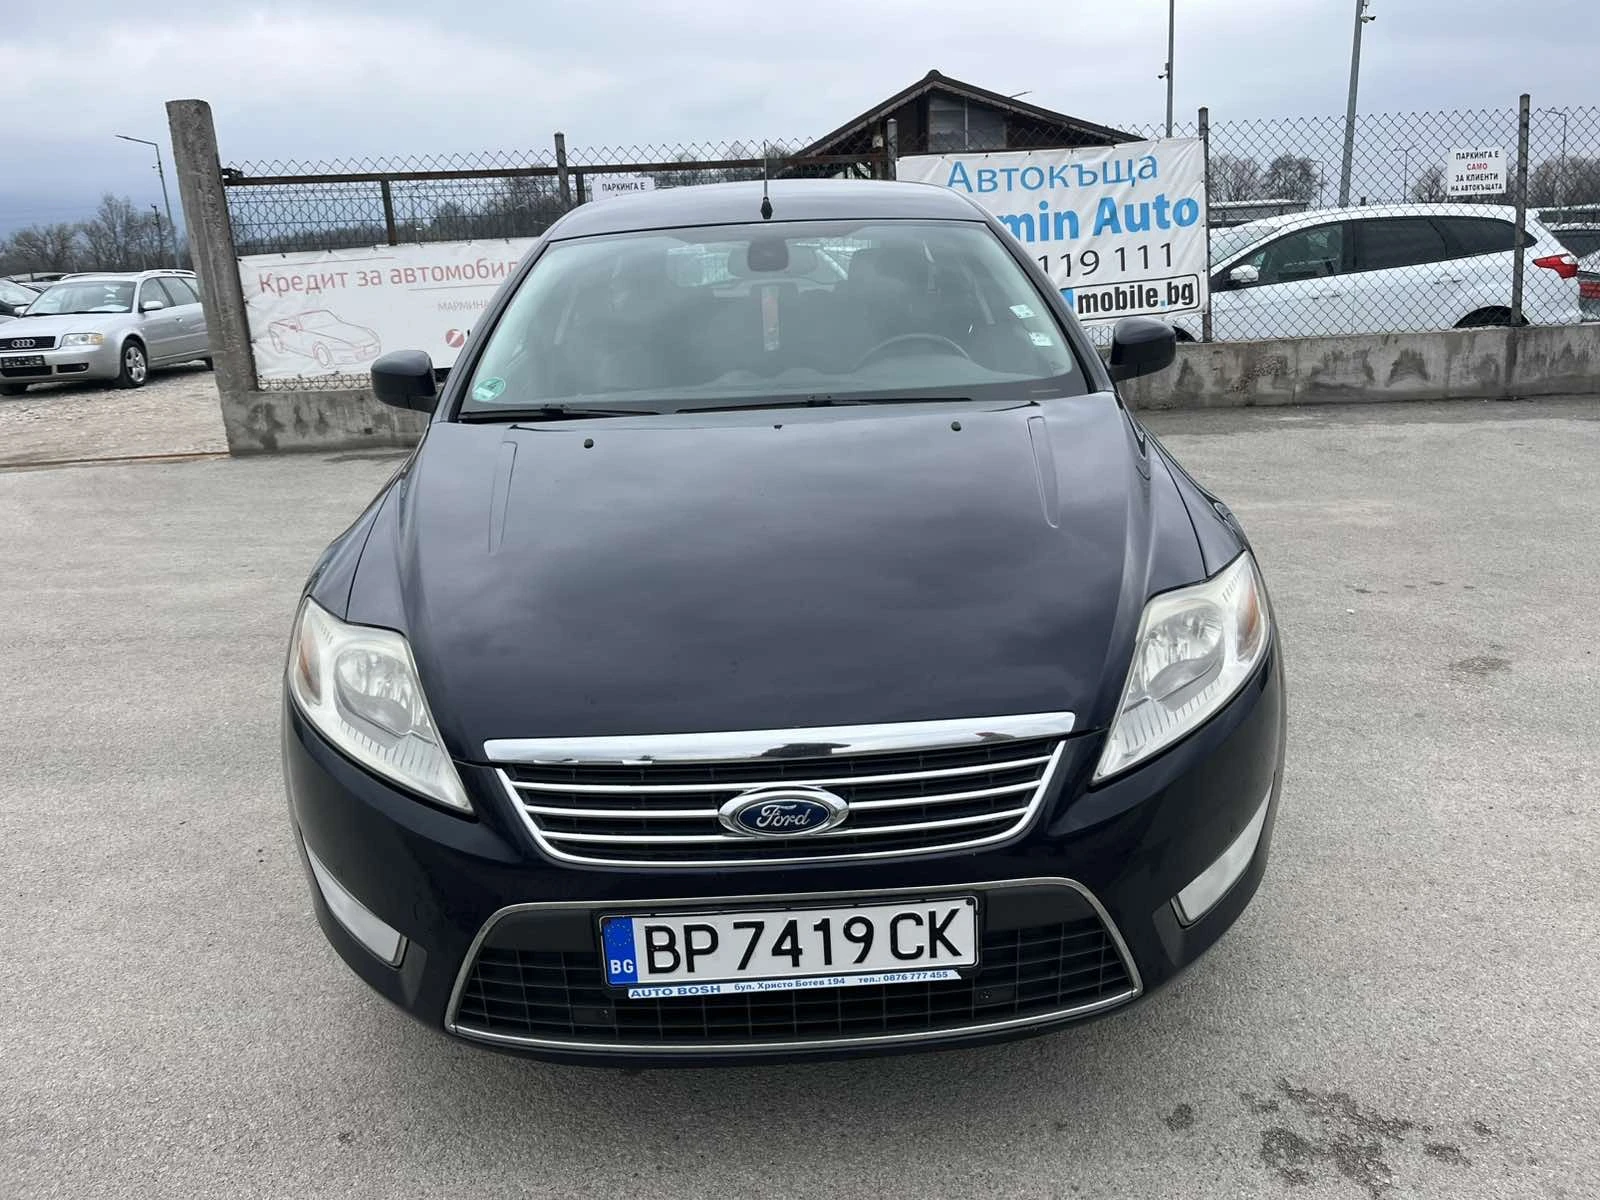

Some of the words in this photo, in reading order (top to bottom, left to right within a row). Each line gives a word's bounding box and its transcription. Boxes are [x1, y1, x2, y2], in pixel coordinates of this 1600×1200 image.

[1456, 152, 1492, 160] ПАРКИНГА
[1494, 150, 1499, 158] Е
[1466, 162, 1488, 171] САМО
[602, 182, 639, 192] ПАРКИНГА
[640, 182, 645, 190] Е
[947, 156, 1158, 193] Автокъща
[1455, 174, 1464, 182] ЗА
[1466, 172, 1499, 182] КЛИЕНТИ
[1461, 183, 1502, 192] АВТОКЪЩАТА
[1093, 193, 1199, 236] Auto
[1115, 242, 1171, 272] 111
[258, 271, 349, 297] Кредит
[356, 269, 383, 287] за
[1077, 281, 1194, 315] mobile.bg
[756, 804, 811, 827] Ford
[733, 915, 875, 971] 7419
[610, 959, 635, 974] BG
[631, 988, 673, 998] AUTO
[678, 985, 721, 996] BOSH
[734, 983, 756, 991] бул.
[757, 981, 793, 990] Христо
[795, 979, 825, 987] Ботев
[828, 977, 846, 985] 194
[883, 972, 908, 982] 0876
[910, 971, 928, 980] 777
[930, 970, 948, 979] 455
